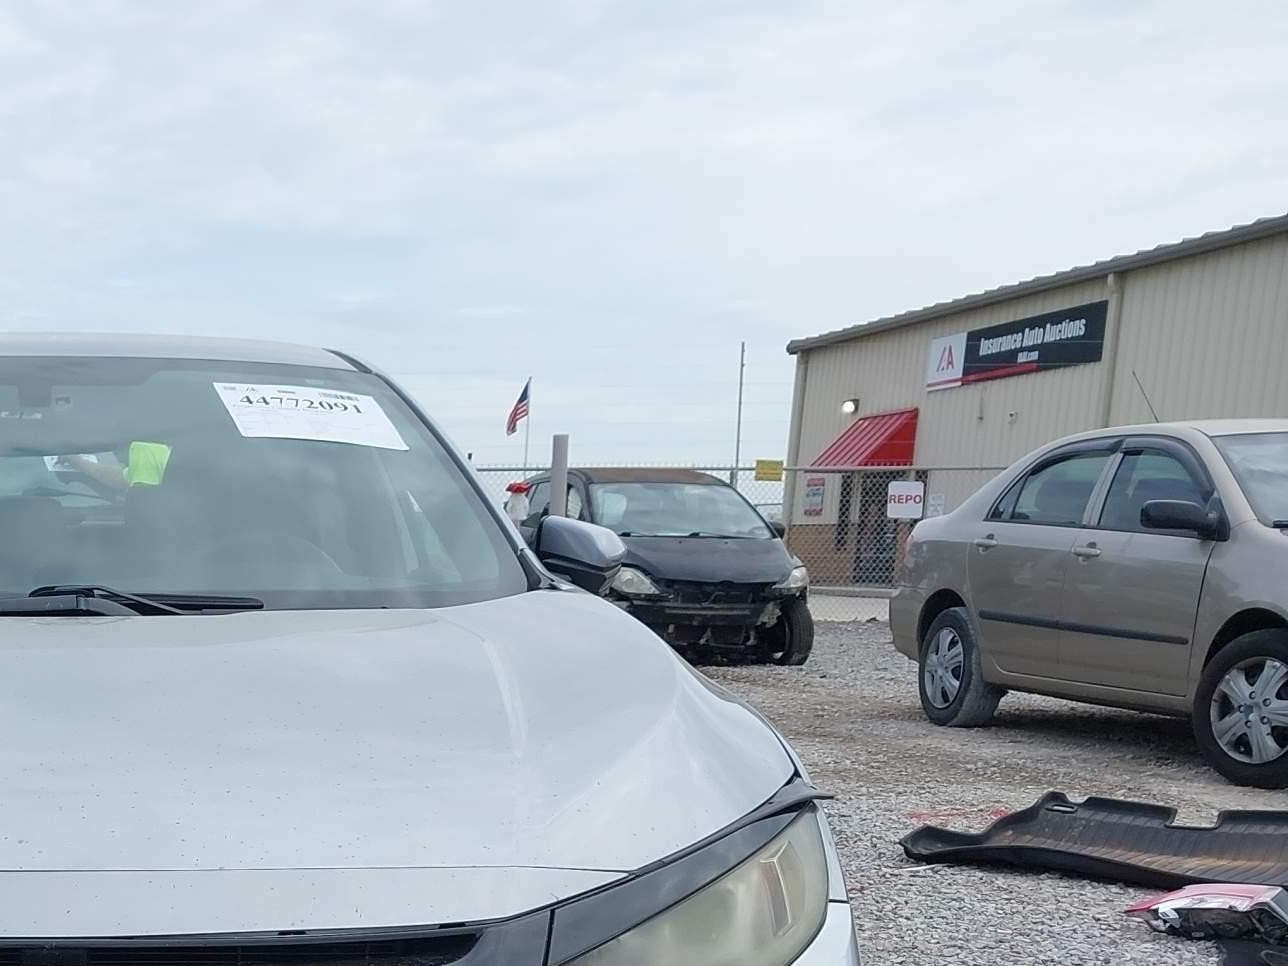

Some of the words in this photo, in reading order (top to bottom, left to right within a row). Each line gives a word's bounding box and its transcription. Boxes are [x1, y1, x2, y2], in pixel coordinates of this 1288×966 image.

[979, 332, 1022, 356] Insurance
[1022, 326, 1043, 347] Auto
[1044, 318, 1086, 343] Auctions
[239, 394, 363, 414] 44772091
[888, 494, 922, 505] REPO
